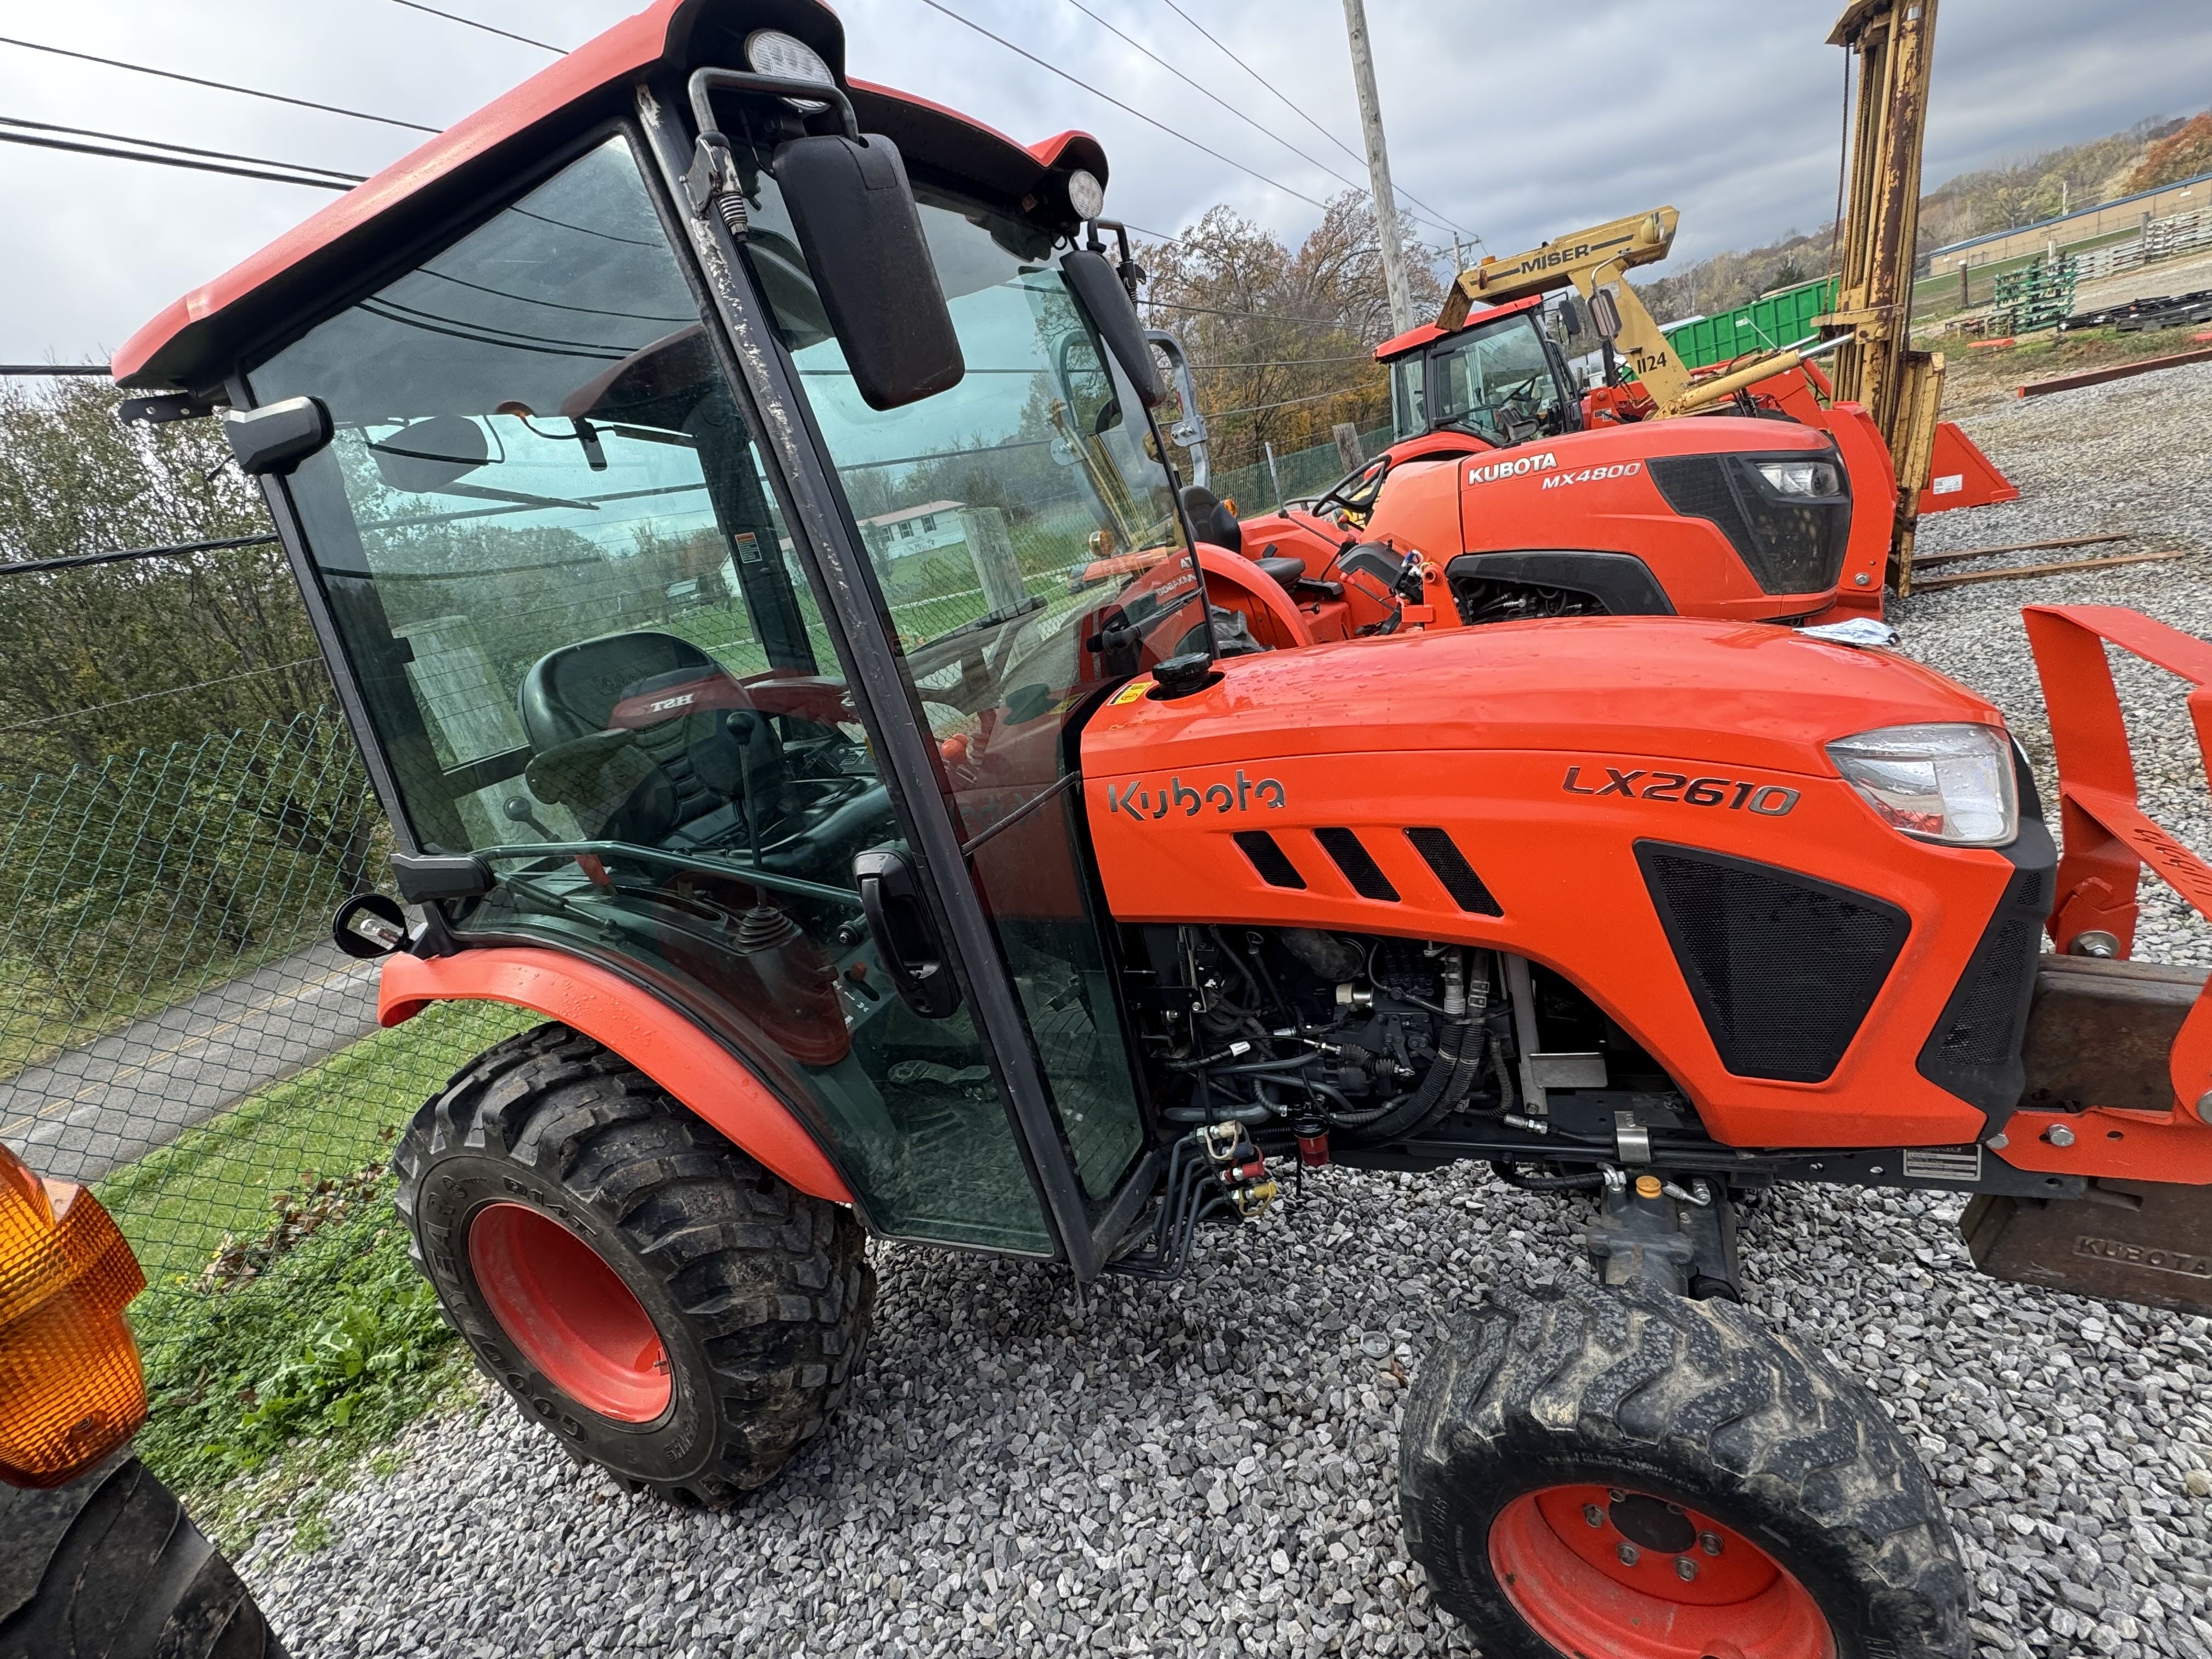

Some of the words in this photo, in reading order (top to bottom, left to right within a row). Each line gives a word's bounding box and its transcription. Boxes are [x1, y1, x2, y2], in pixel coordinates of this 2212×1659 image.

[1521, 244, 1589, 274] MISER
[1637, 352, 1667, 374] 1124
[1468, 452, 1558, 485] KUBOTA
[1542, 462, 1641, 490] MX4800
[1107, 769, 1286, 821] Kubota
[1562, 765, 1801, 816] LX2610
[2080, 1238, 2208, 1273] KUBOTA
[425, 1192, 588, 1444] GOODYEAR
